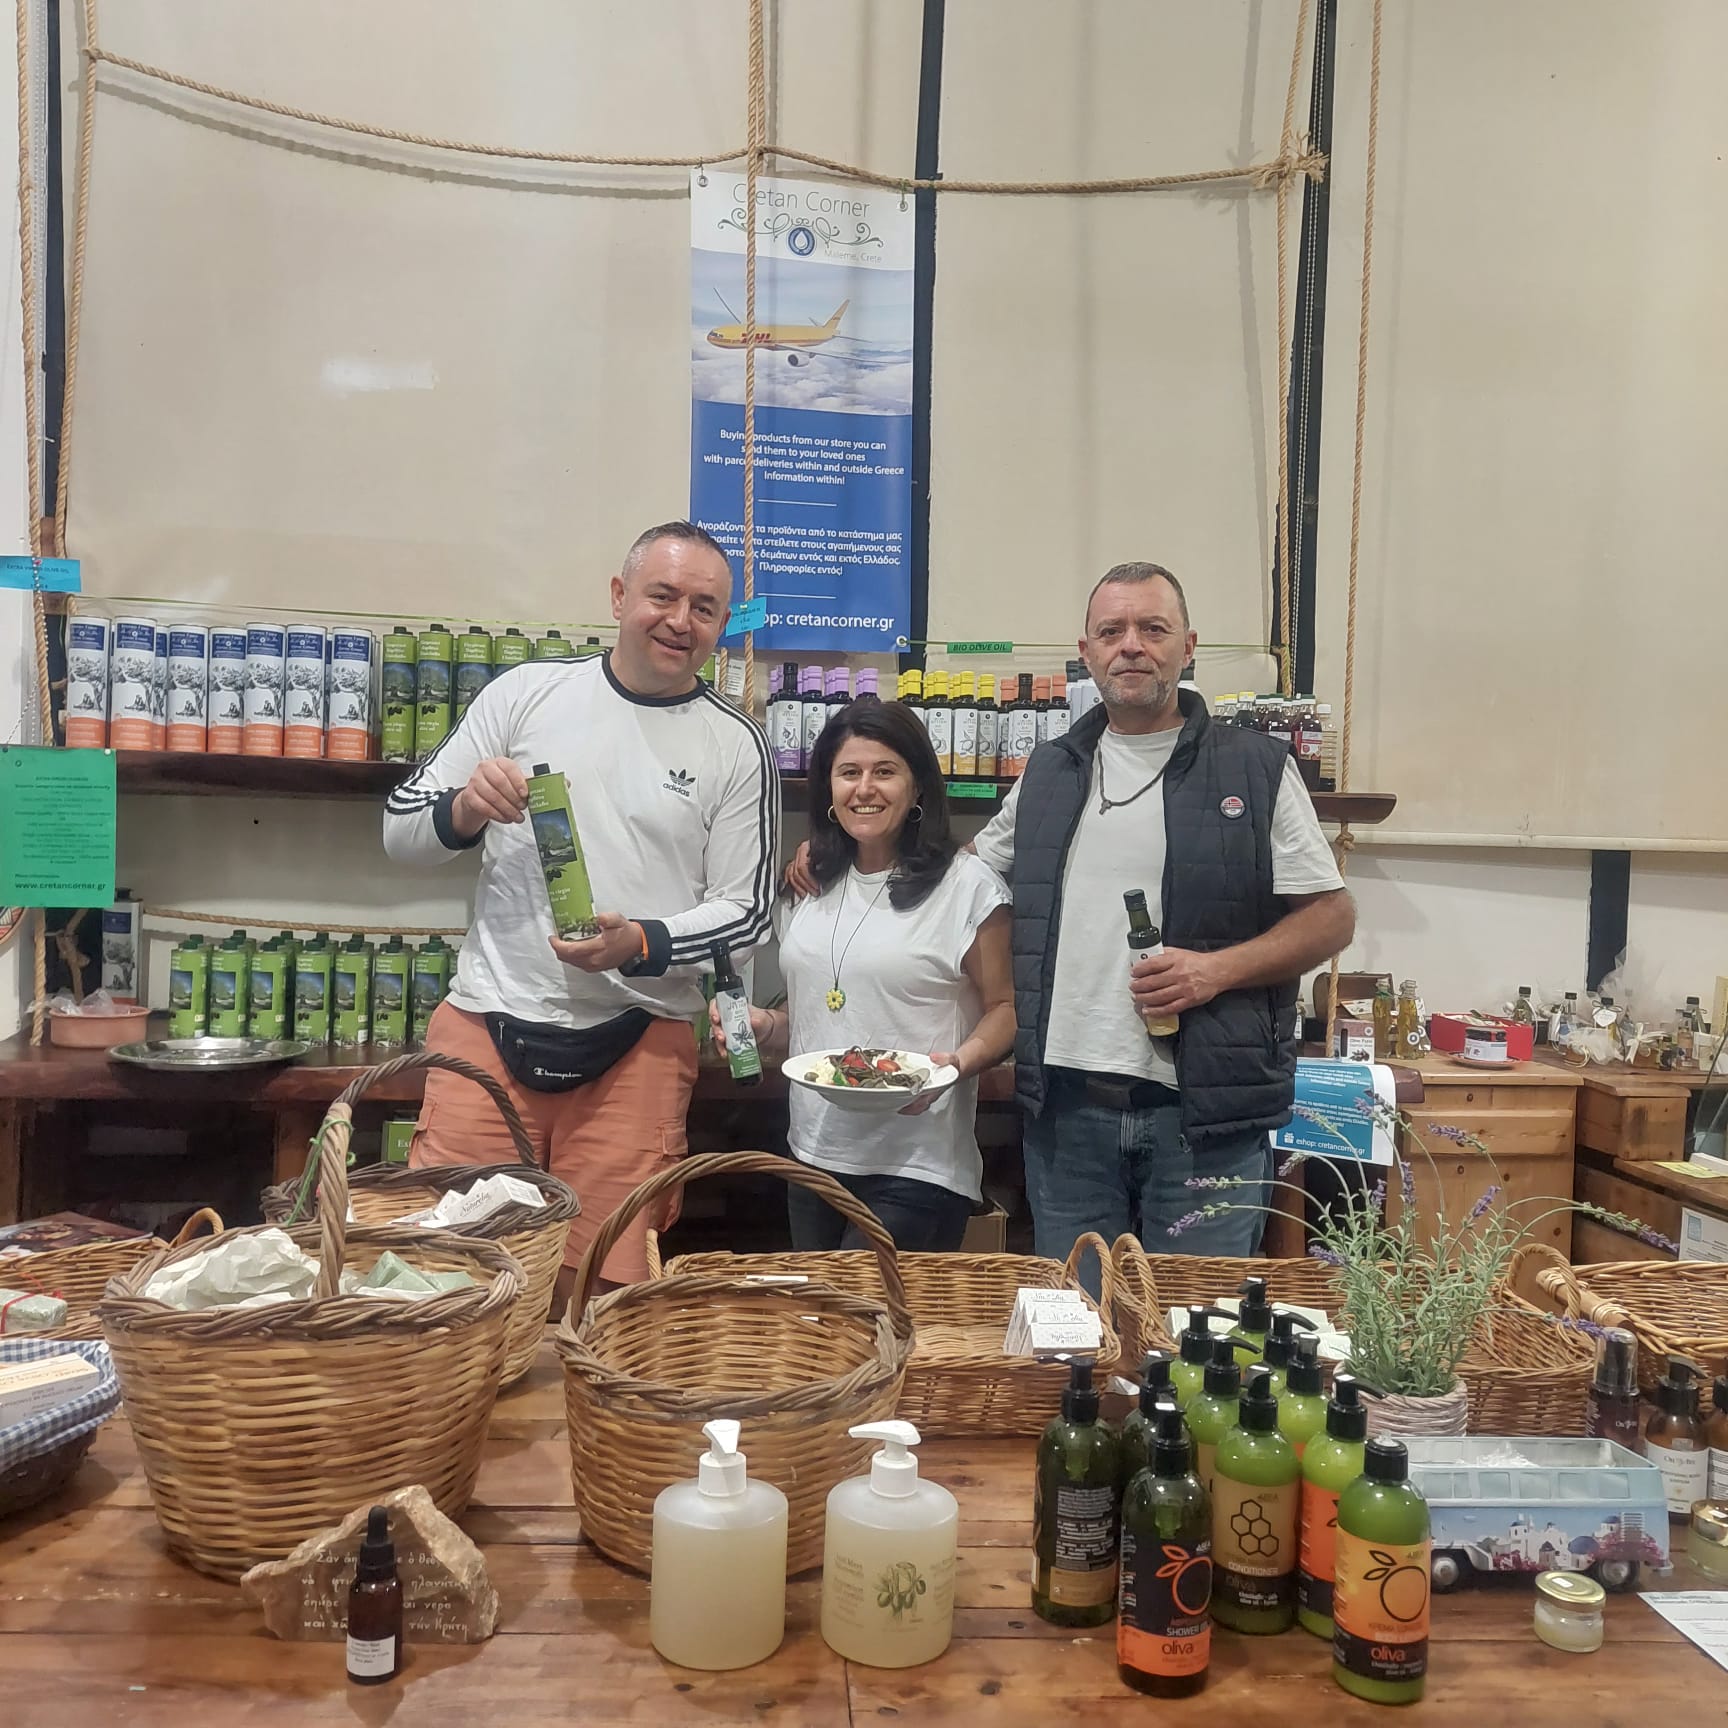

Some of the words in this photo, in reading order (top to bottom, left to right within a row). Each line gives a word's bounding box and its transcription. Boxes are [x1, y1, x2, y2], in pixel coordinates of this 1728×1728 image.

[733, 183, 798, 209] Cetan
[806, 191, 871, 218] Corner
[860, 252, 883, 263] Crete
[720, 429, 751, 443] Buyin
[752, 433, 791, 445] products
[792, 434, 812, 444] from
[815, 438, 829, 446] our
[831, 437, 851, 448] store
[853, 440, 869, 452] you
[871, 442, 886, 450] can
[741, 444, 762, 456] snd
[764, 446, 786, 456] them
[788, 449, 798, 457] to
[800, 449, 819, 461] your
[820, 449, 843, 460] loved
[845, 452, 866, 461] ones
[704, 454, 723, 464] with
[754, 457, 793, 469] deliveries
[795, 460, 822, 471] within
[824, 462, 840, 472] and
[842, 463, 873, 474] outside
[875, 465, 904, 475] Greece
[764, 471, 814, 483] Information
[816, 474, 845, 485] within!
[697, 520, 752, 534] Αγοράζοντ
[767, 525, 806, 538] προϊόντα
[809, 528, 825, 539] από
[827, 530, 836, 538] το
[838, 529, 884, 542] κατάστημα
[886, 532, 902, 542] μας
[753, 537, 762, 546] τα
[764, 537, 799, 549] στείλετε
[801, 541, 826, 550] στους
[885, 544, 902, 553] σας
[760, 550, 797, 561] δεμάτων
[799, 553, 822, 563] εντός
[838, 554, 862, 564] εκτός
[759, 564, 816, 575] Πληροφορίες
[817, 566, 843, 576] εντός!
[787, 613, 894, 632] cretancorner.gr
[953, 644, 967, 652] BIO
[969, 643, 992, 652] OLIVE
[994, 643, 1006, 652] OIL
[662, 782, 691, 798] adidas
[533, 1067, 583, 1080] Champion
[1295, 1139, 1316, 1149] eshop:
[1227, 1561, 1279, 1577] CONDITIONER
[1225, 1575, 1257, 1592] oliva
[1166, 1624, 1200, 1637] SHOWER
[1161, 1639, 1194, 1655] oliva
[1370, 1646, 1406, 1662] oliva
